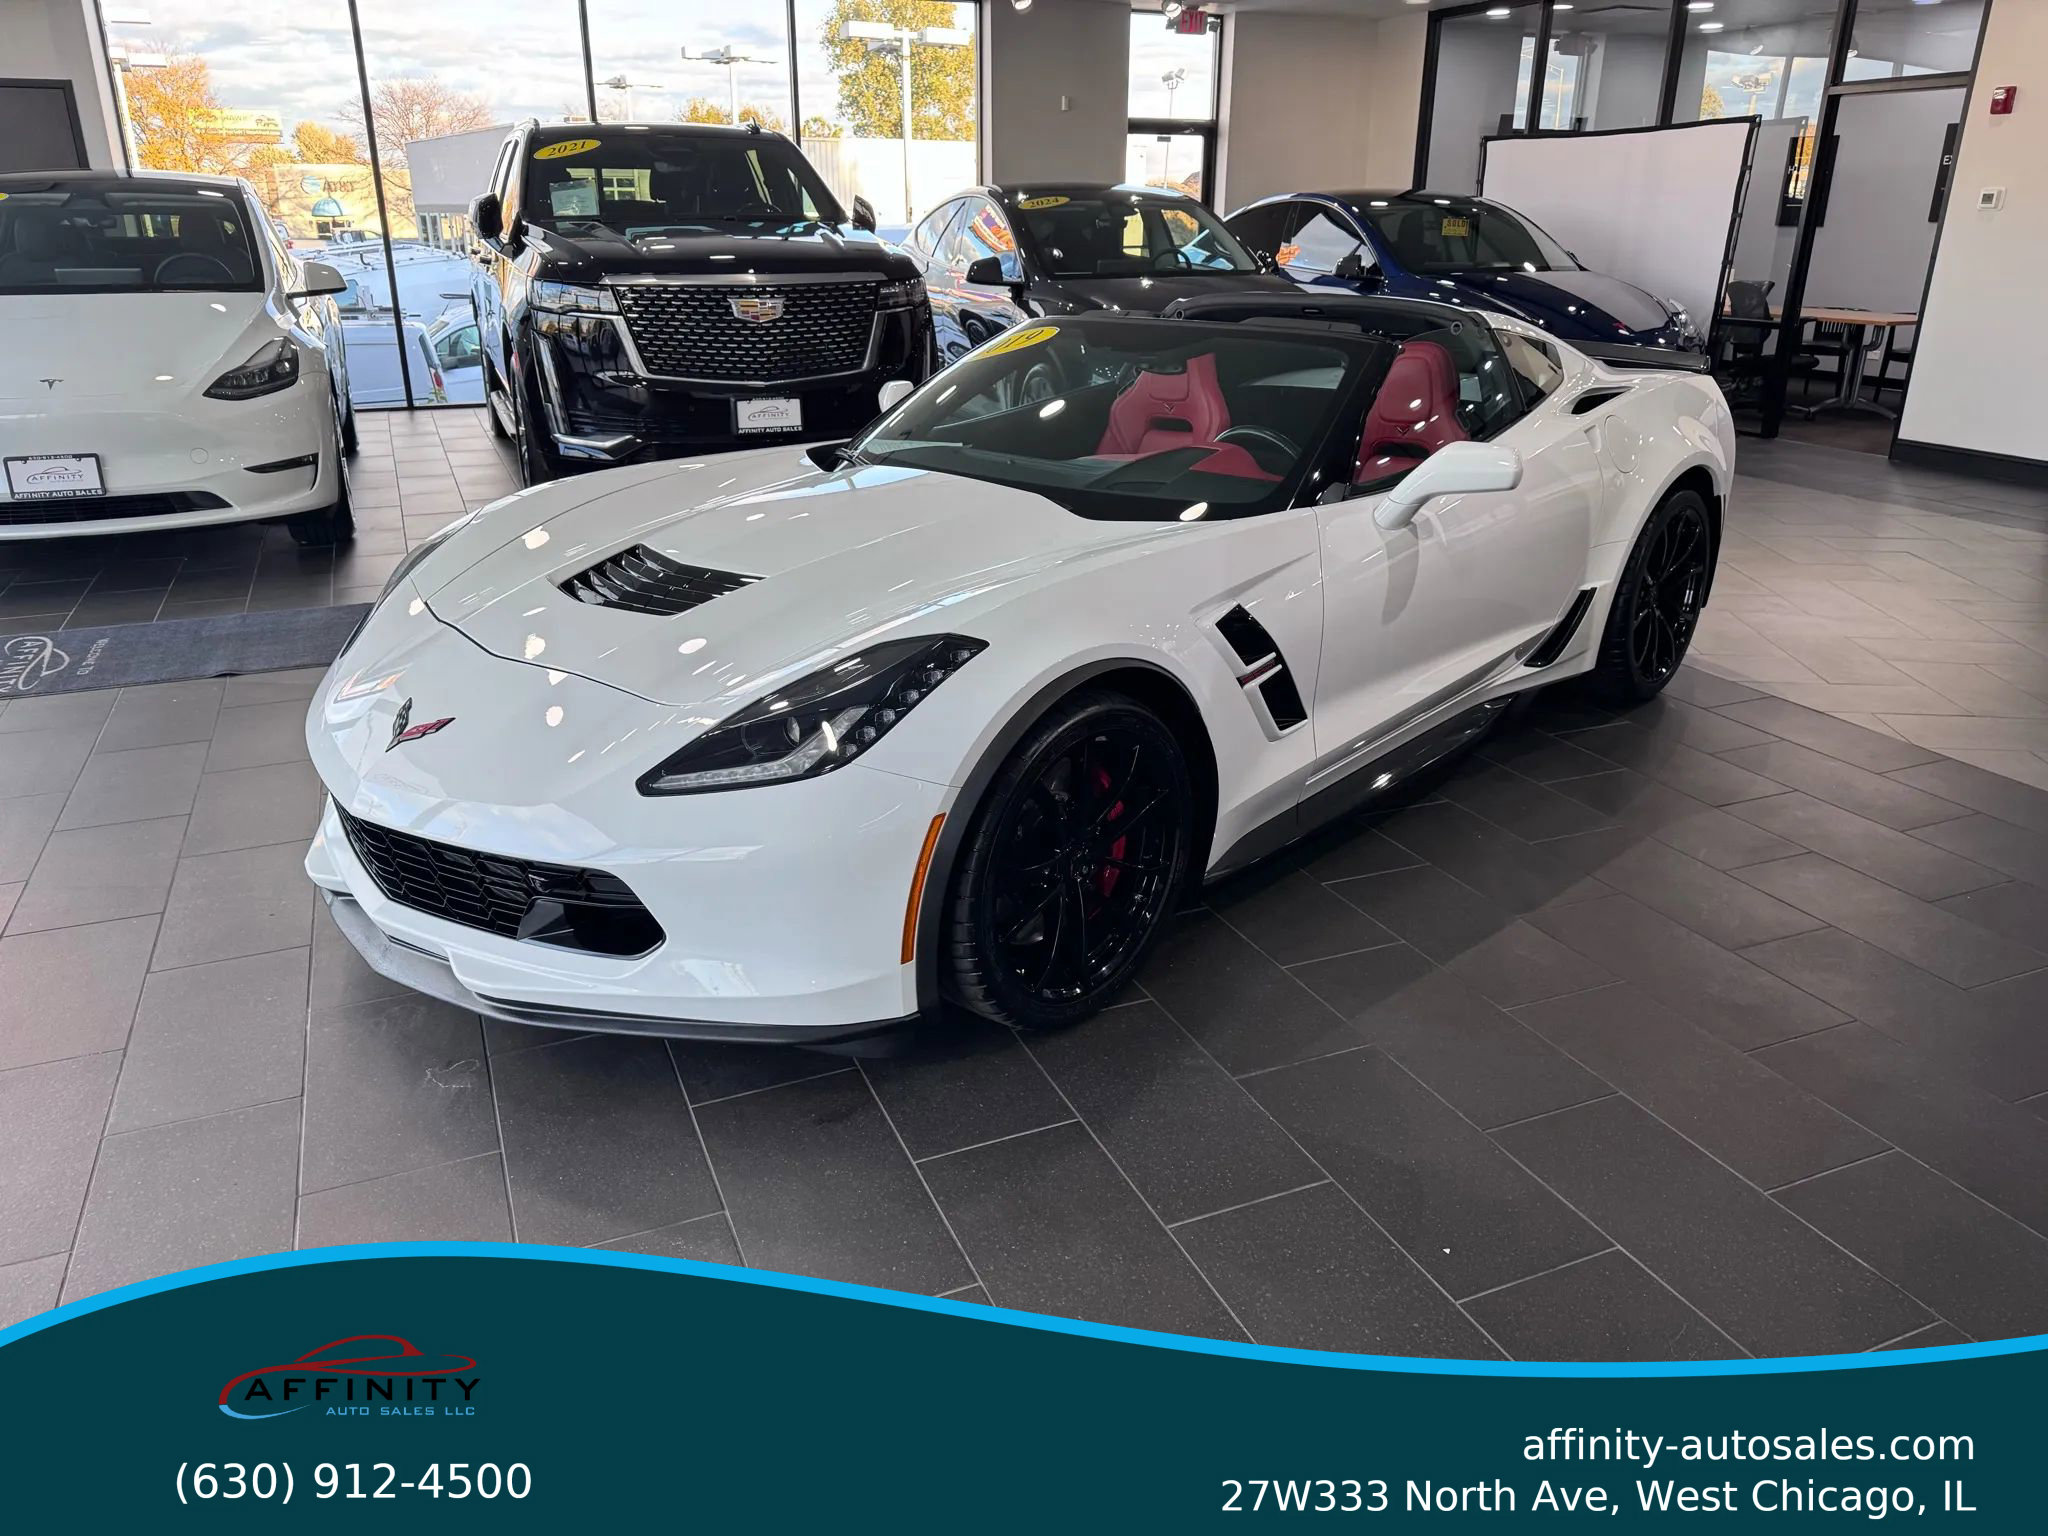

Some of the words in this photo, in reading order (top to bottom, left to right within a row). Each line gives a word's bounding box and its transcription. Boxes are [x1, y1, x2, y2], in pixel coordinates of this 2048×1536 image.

[1181, 12, 1205, 32] EXIT
[547, 141, 586, 156] 2021
[1031, 198, 1059, 208] 2024
[32, 473, 84, 481] AFFINITY
[14, 491, 50, 500] AFFINITY
[0, 640, 44, 693] AFFINITY
